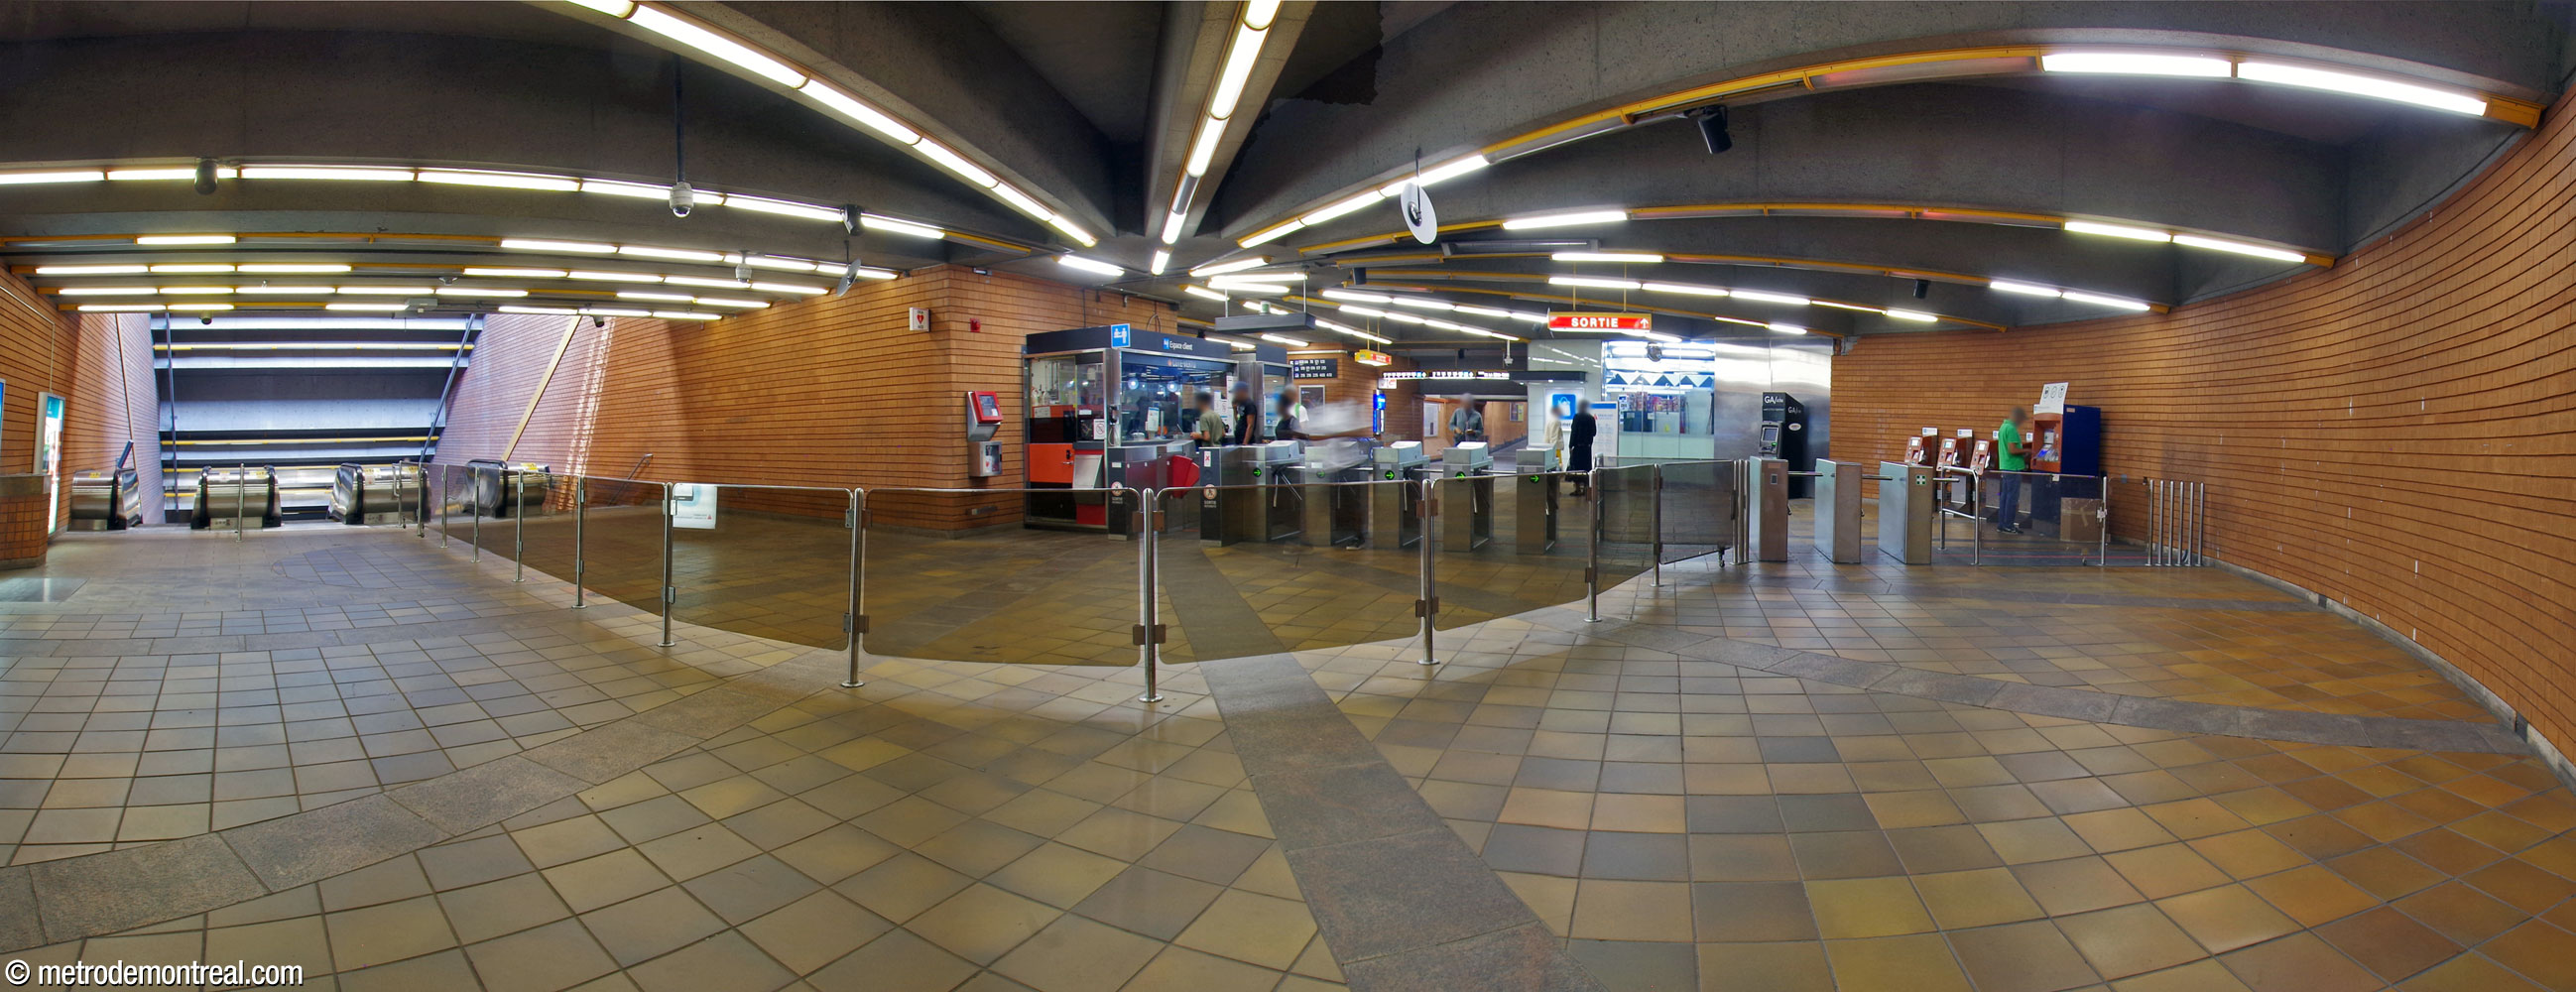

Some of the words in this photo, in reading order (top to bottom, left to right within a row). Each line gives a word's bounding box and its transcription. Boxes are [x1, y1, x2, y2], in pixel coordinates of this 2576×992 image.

[1571, 317, 1619, 327] SORTIE
[1169, 340, 1182, 350] Espace
[1182, 341, 1193, 350] client
